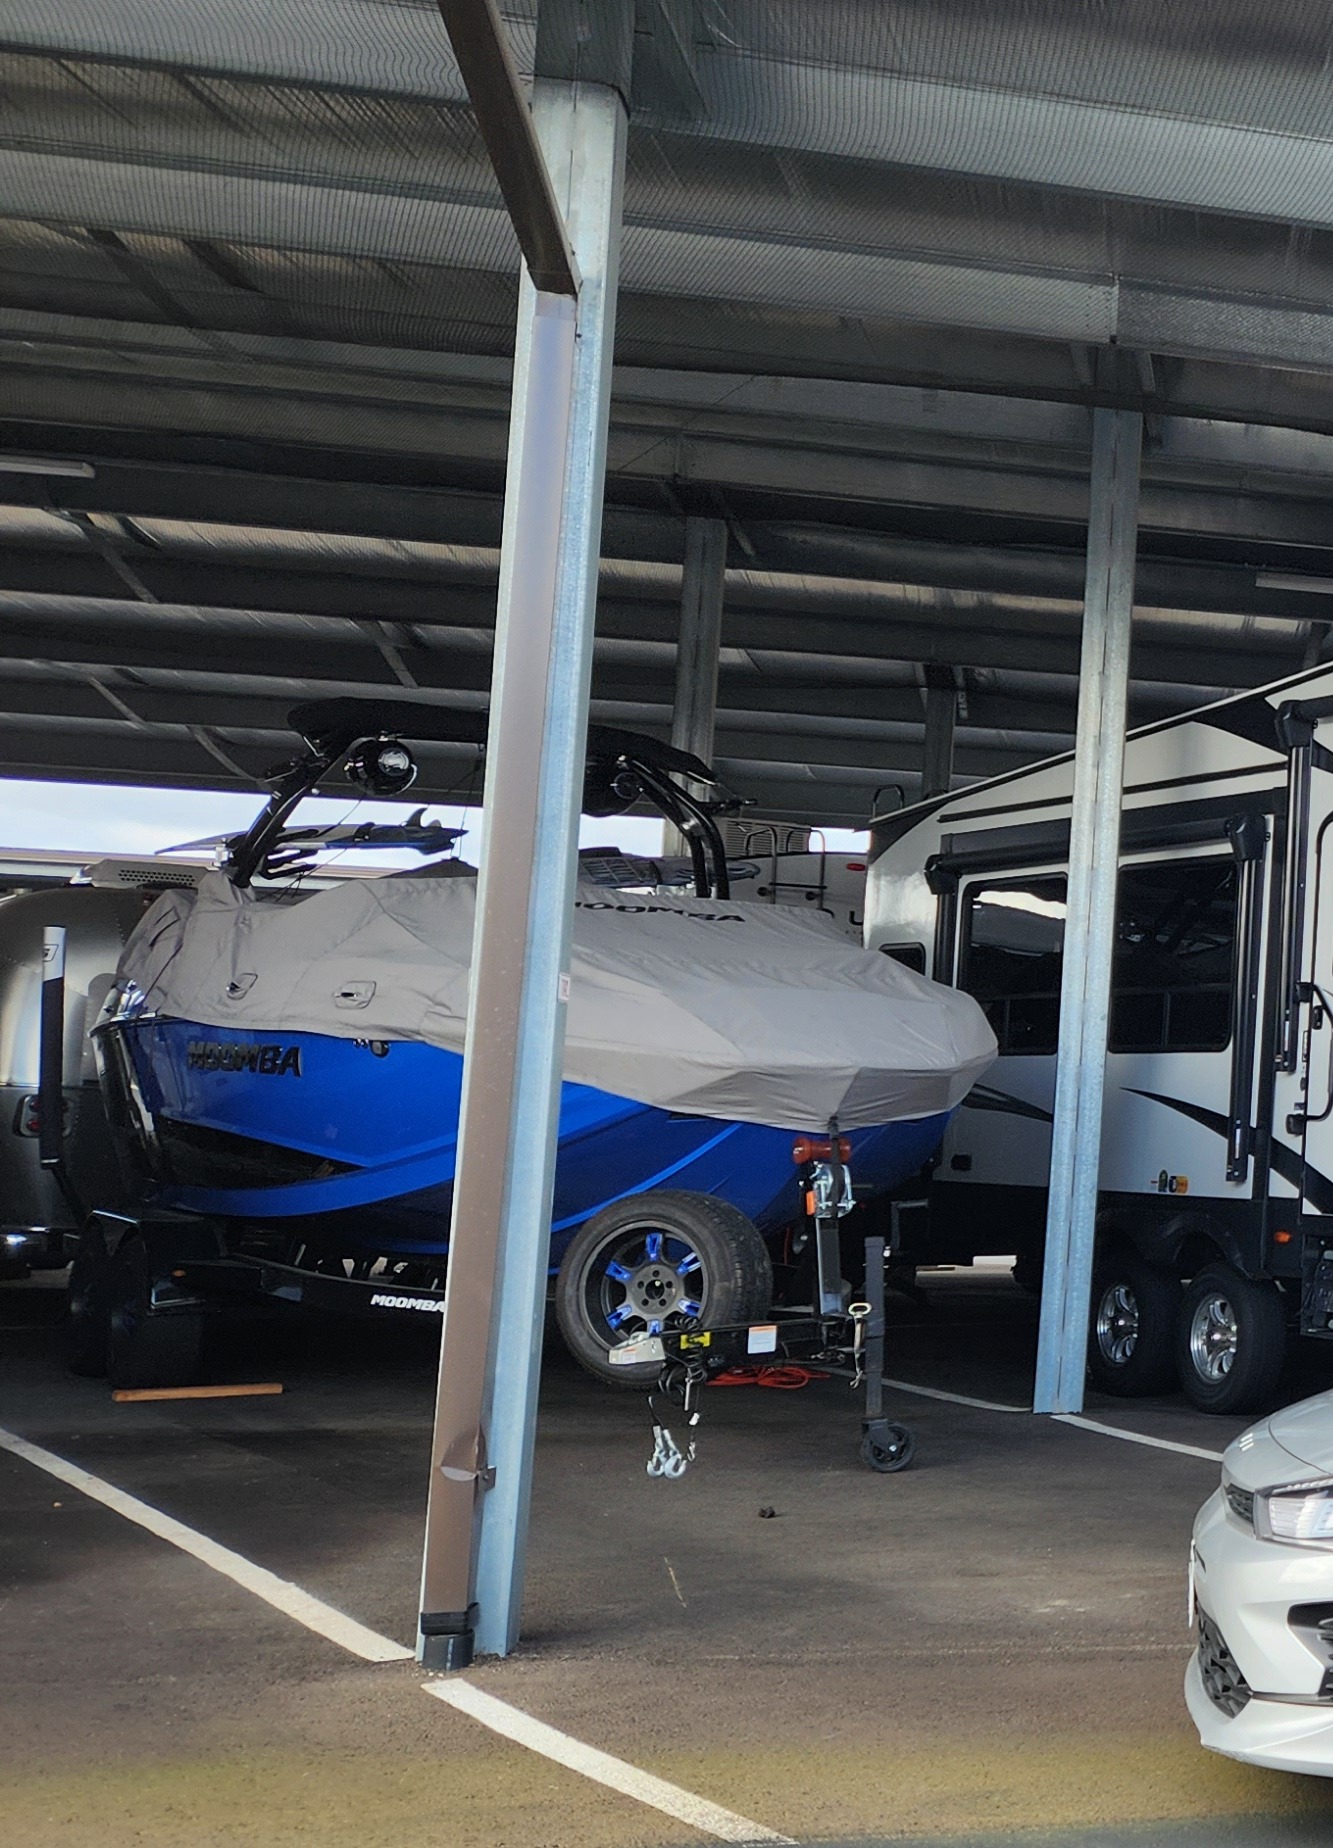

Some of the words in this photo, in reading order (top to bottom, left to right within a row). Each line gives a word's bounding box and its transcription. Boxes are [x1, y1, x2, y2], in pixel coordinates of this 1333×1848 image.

[574, 902, 746, 923] OOMBA
[188, 1041, 302, 1078] MOOMBA
[370, 1294, 447, 1313] MOOMBA
